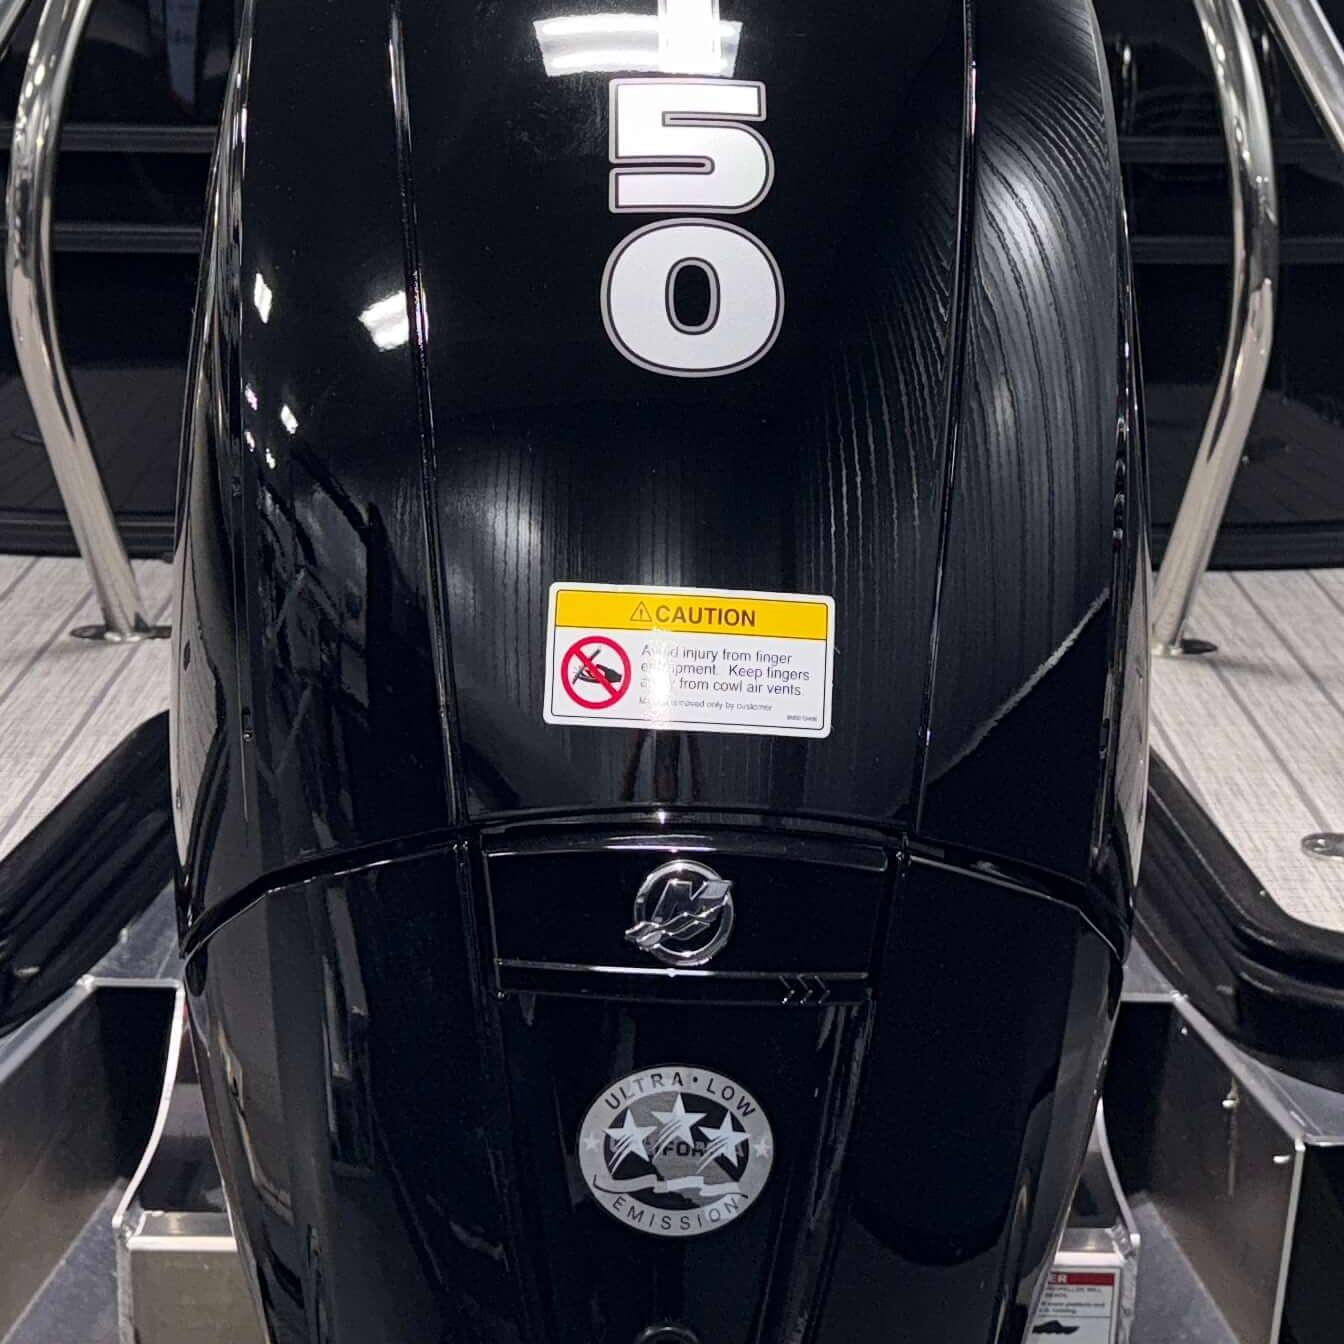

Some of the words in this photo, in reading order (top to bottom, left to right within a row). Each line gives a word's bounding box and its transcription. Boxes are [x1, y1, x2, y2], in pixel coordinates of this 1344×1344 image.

[654, 604, 756, 628] CAUTION
[683, 648, 718, 663] injury
[722, 648, 752, 662] from
[756, 650, 793, 667] finger
[729, 664, 763, 680] Keep
[767, 666, 810, 683] fingers
[679, 677, 709, 691] from
[713, 680, 743, 693] cowl
[746, 681, 763, 694] air
[604, 1071, 685, 1111] ULTRA
[706, 1077, 756, 1118] LOW
[612, 1195, 739, 1230] EMISSION
